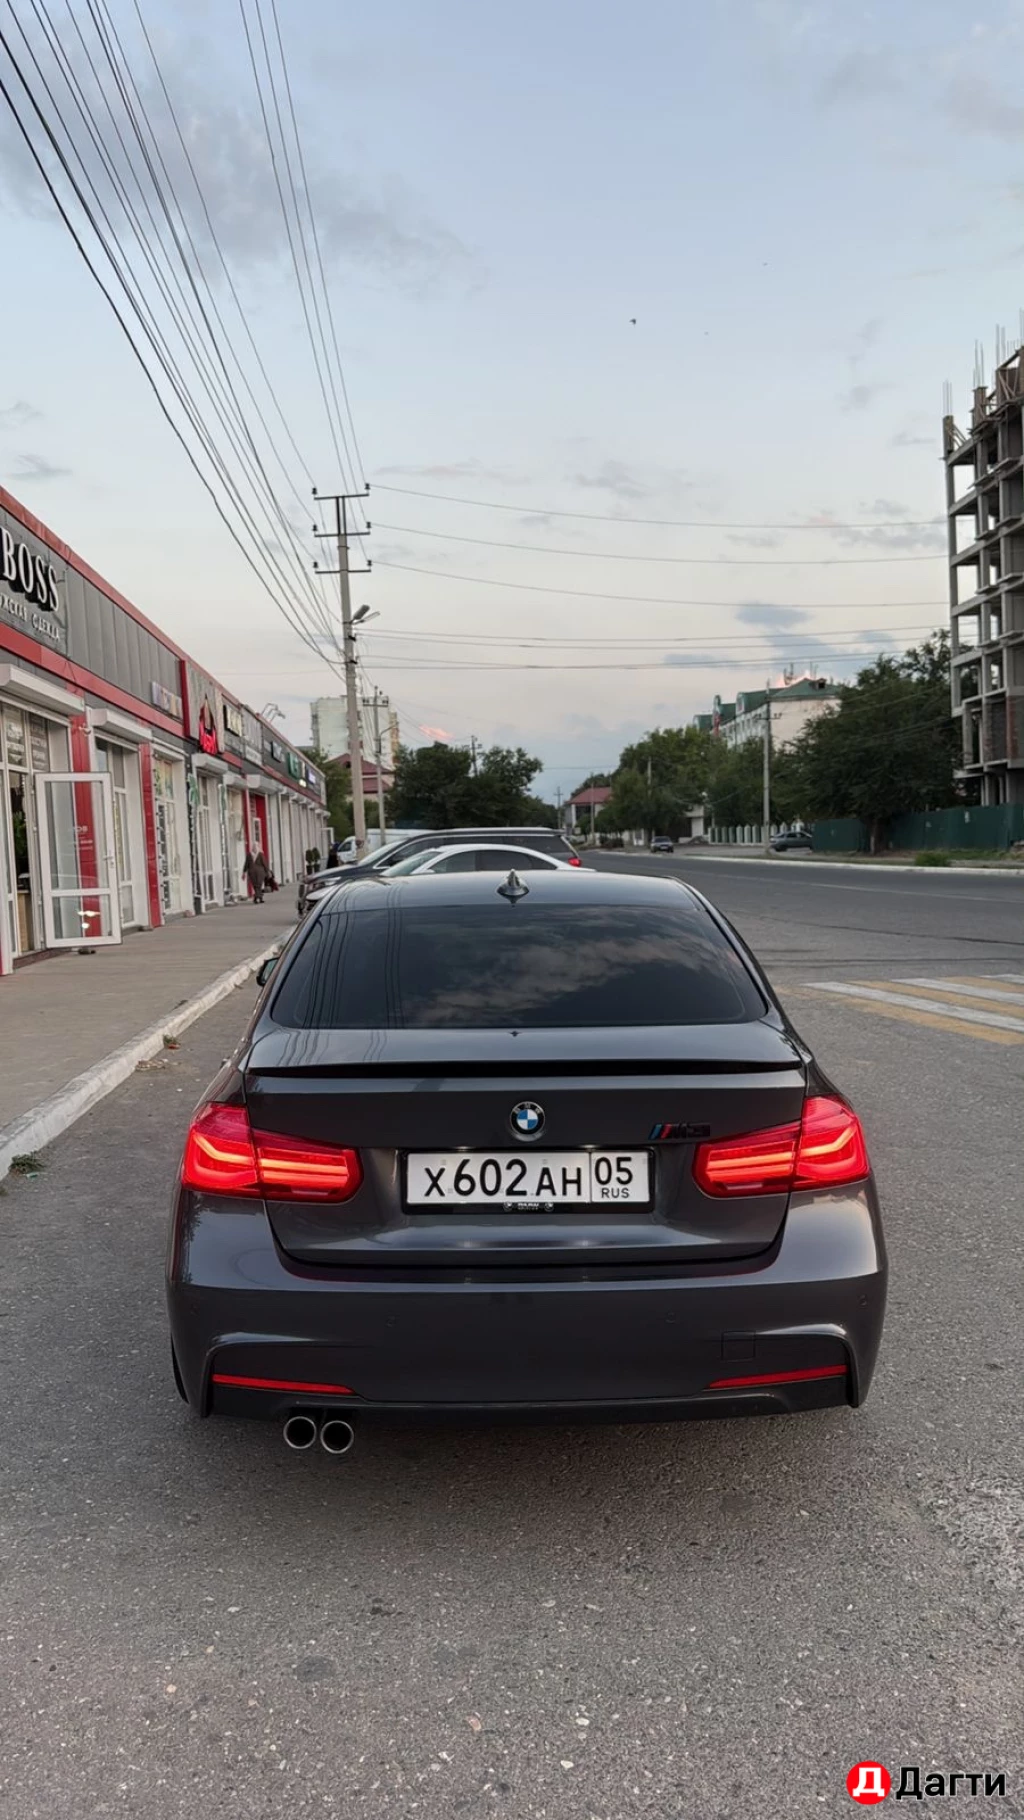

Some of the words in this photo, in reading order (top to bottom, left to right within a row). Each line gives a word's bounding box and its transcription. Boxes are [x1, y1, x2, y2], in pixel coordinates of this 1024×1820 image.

[1, 527, 59, 612] BOSS
[594, 1157, 633, 1186] 05
[601, 1187, 630, 1199] RUS
